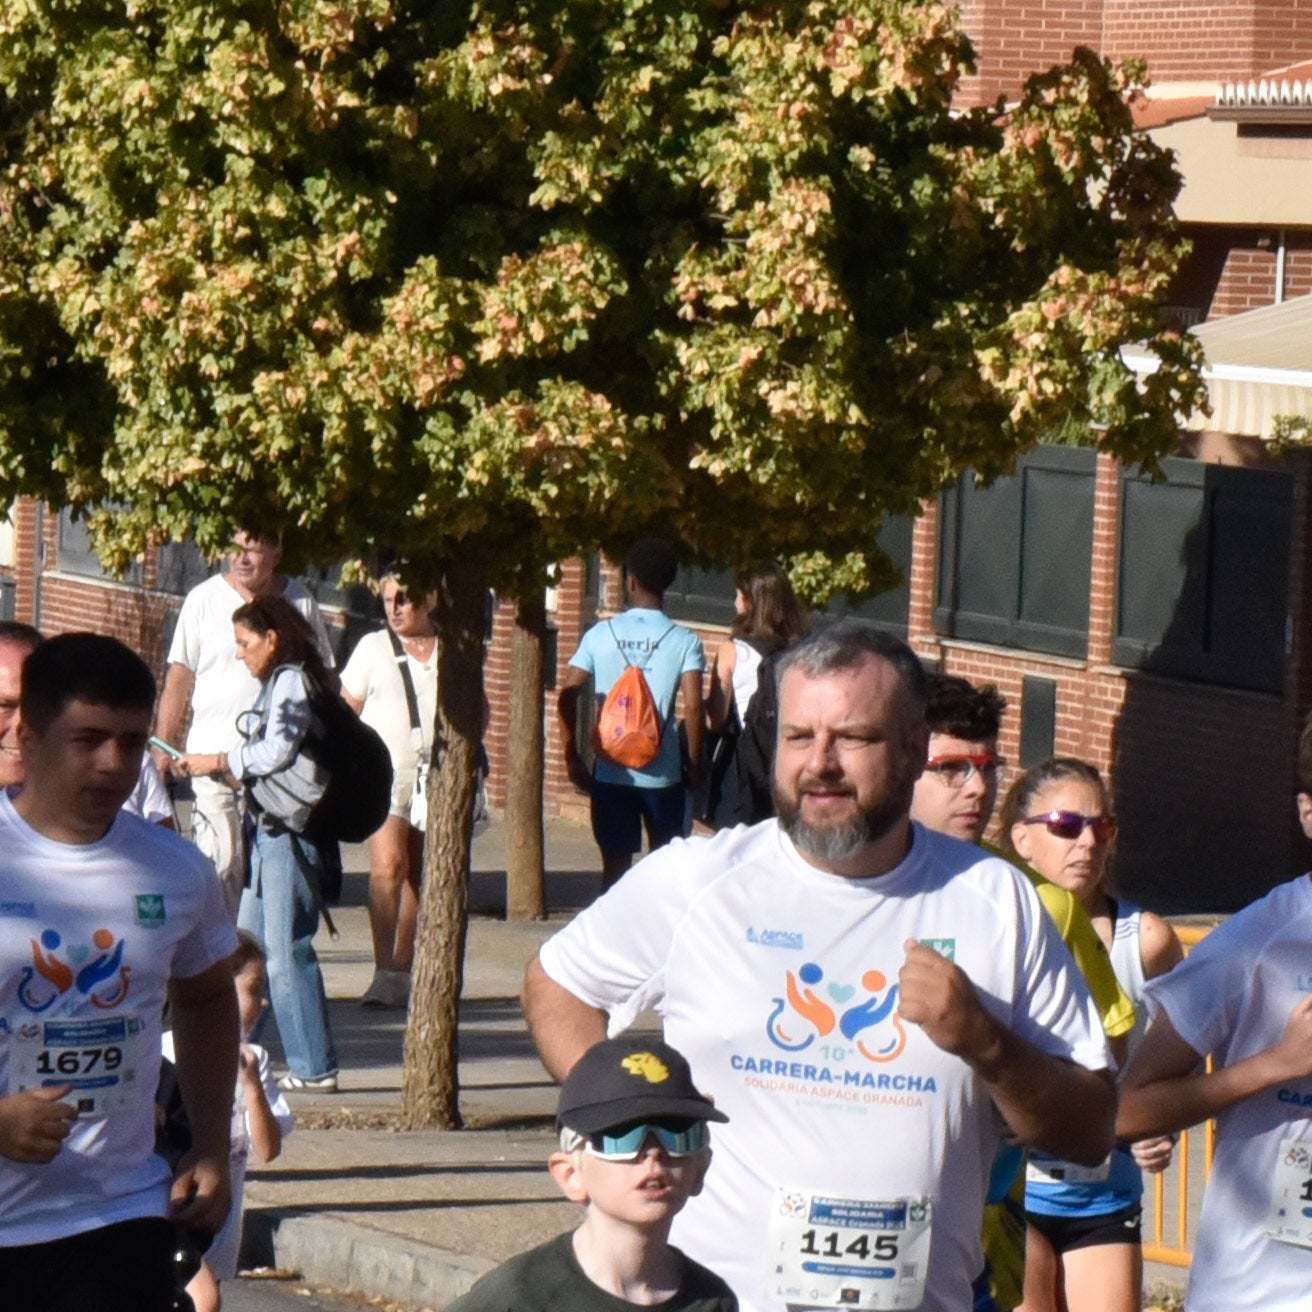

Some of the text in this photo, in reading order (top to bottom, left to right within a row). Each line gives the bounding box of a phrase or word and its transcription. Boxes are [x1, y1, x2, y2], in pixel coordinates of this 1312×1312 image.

[36, 1047, 122, 1074] 1679
[731, 1055, 937, 1093] CARRERA-MARCHA
[744, 1076, 923, 1108] SOLIDARIA ASPACE GRANADA
[800, 1229, 899, 1261] 1145
